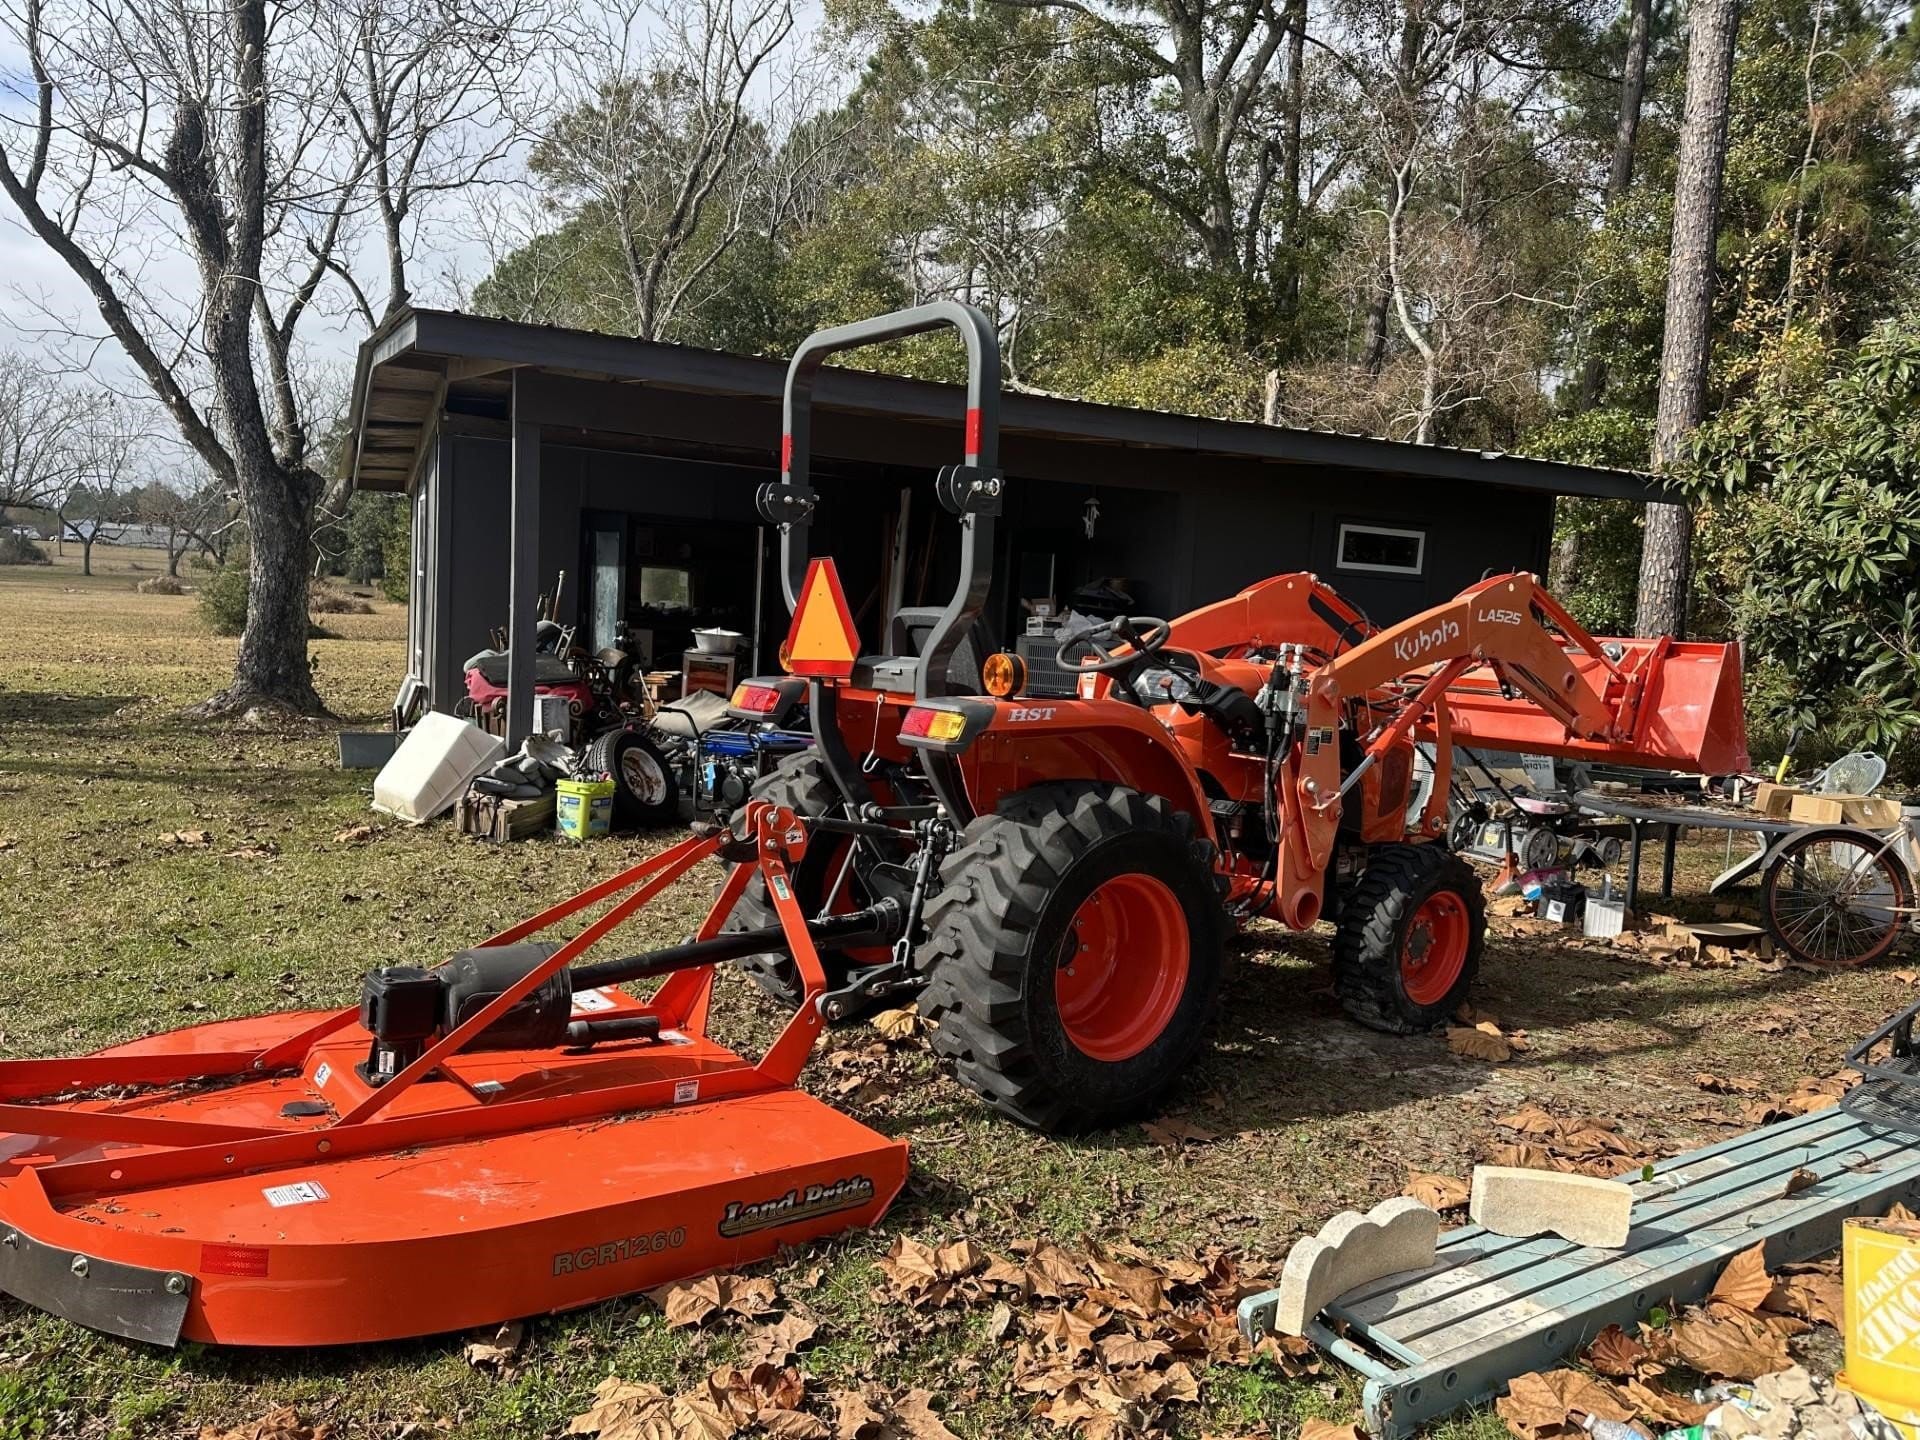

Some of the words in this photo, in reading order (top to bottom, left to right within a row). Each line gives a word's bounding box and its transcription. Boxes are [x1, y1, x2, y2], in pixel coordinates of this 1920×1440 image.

[1478, 609, 1522, 625] LA525
[1394, 619, 1460, 661] Kubota
[1008, 707, 1057, 722] HST
[721, 1189, 798, 1229] Land
[802, 1173, 873, 1209] Pride
[553, 1225, 686, 1276] RCR1260
